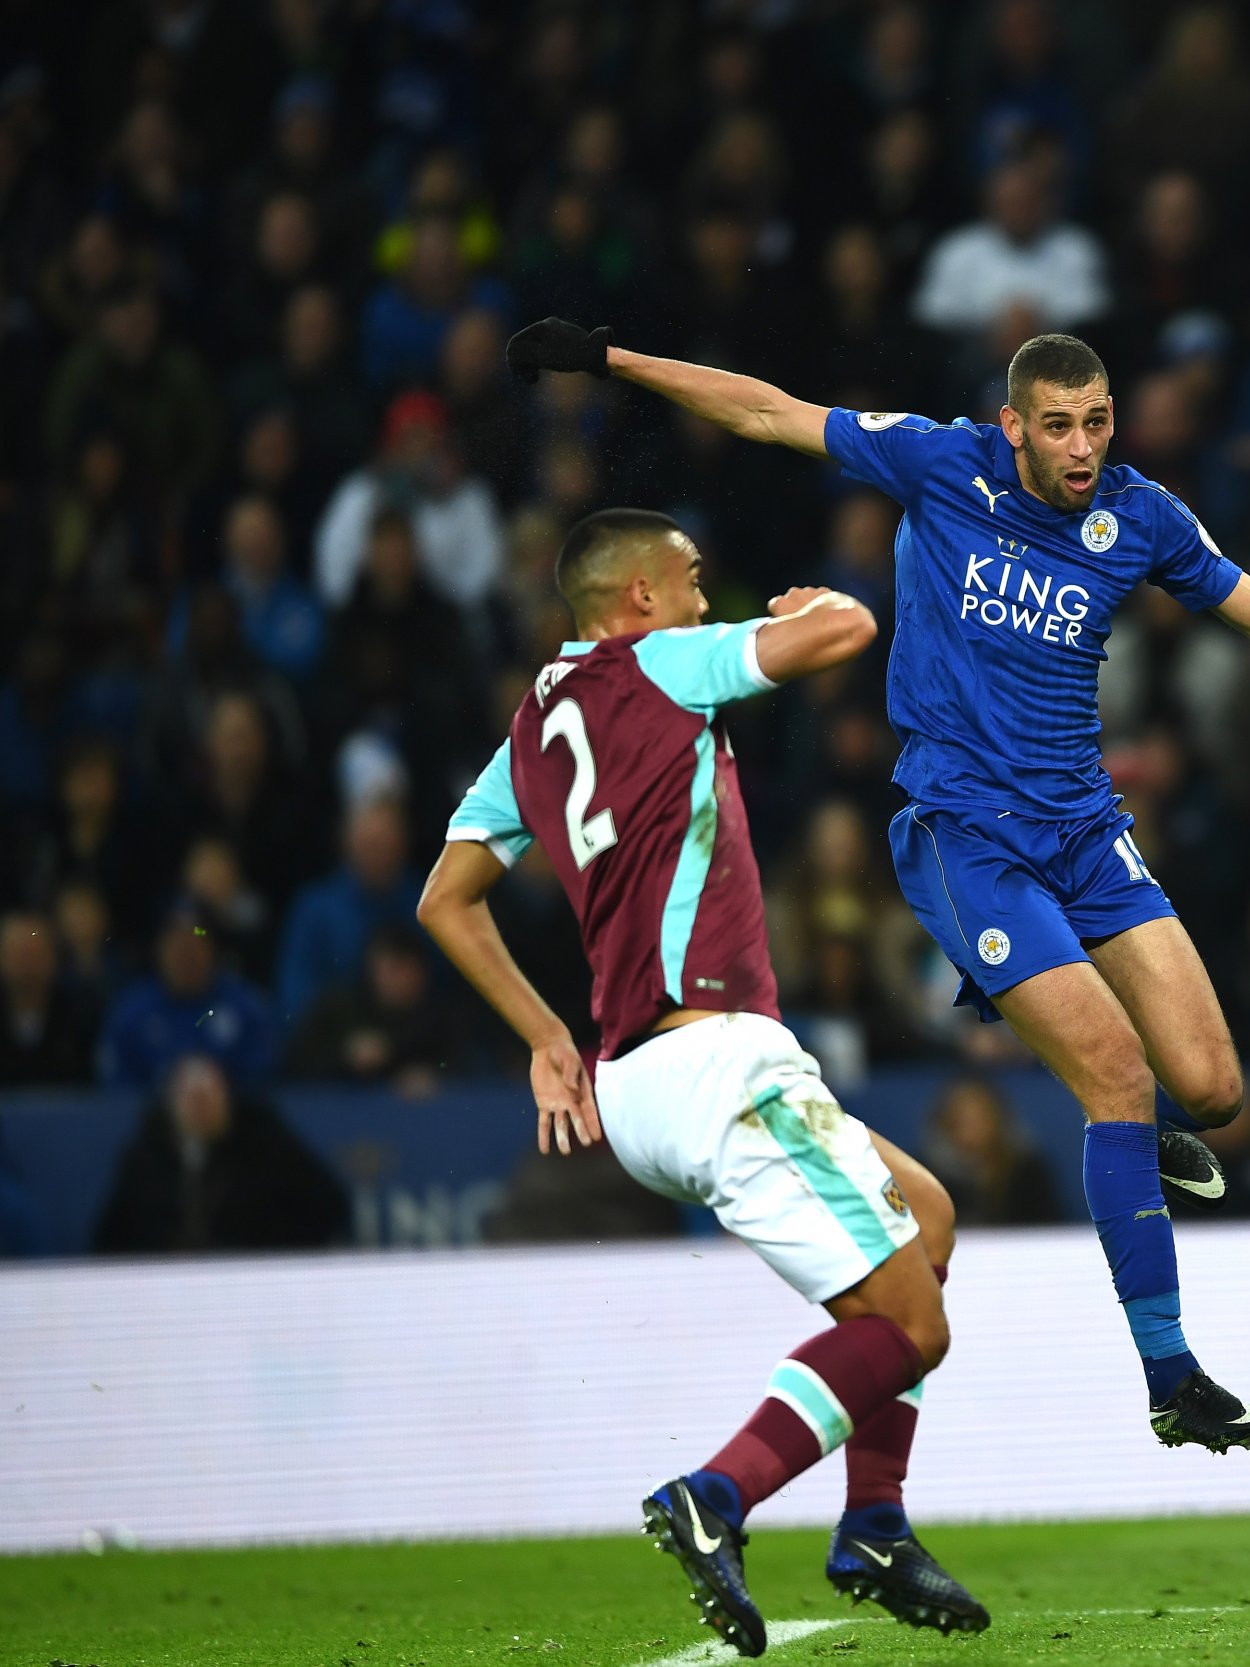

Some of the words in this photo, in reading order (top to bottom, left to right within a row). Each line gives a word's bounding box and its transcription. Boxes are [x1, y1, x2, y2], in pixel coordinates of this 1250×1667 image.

[961, 594, 1082, 648] POWER
[965, 554, 1090, 621] KING
[541, 697, 619, 873] 2
